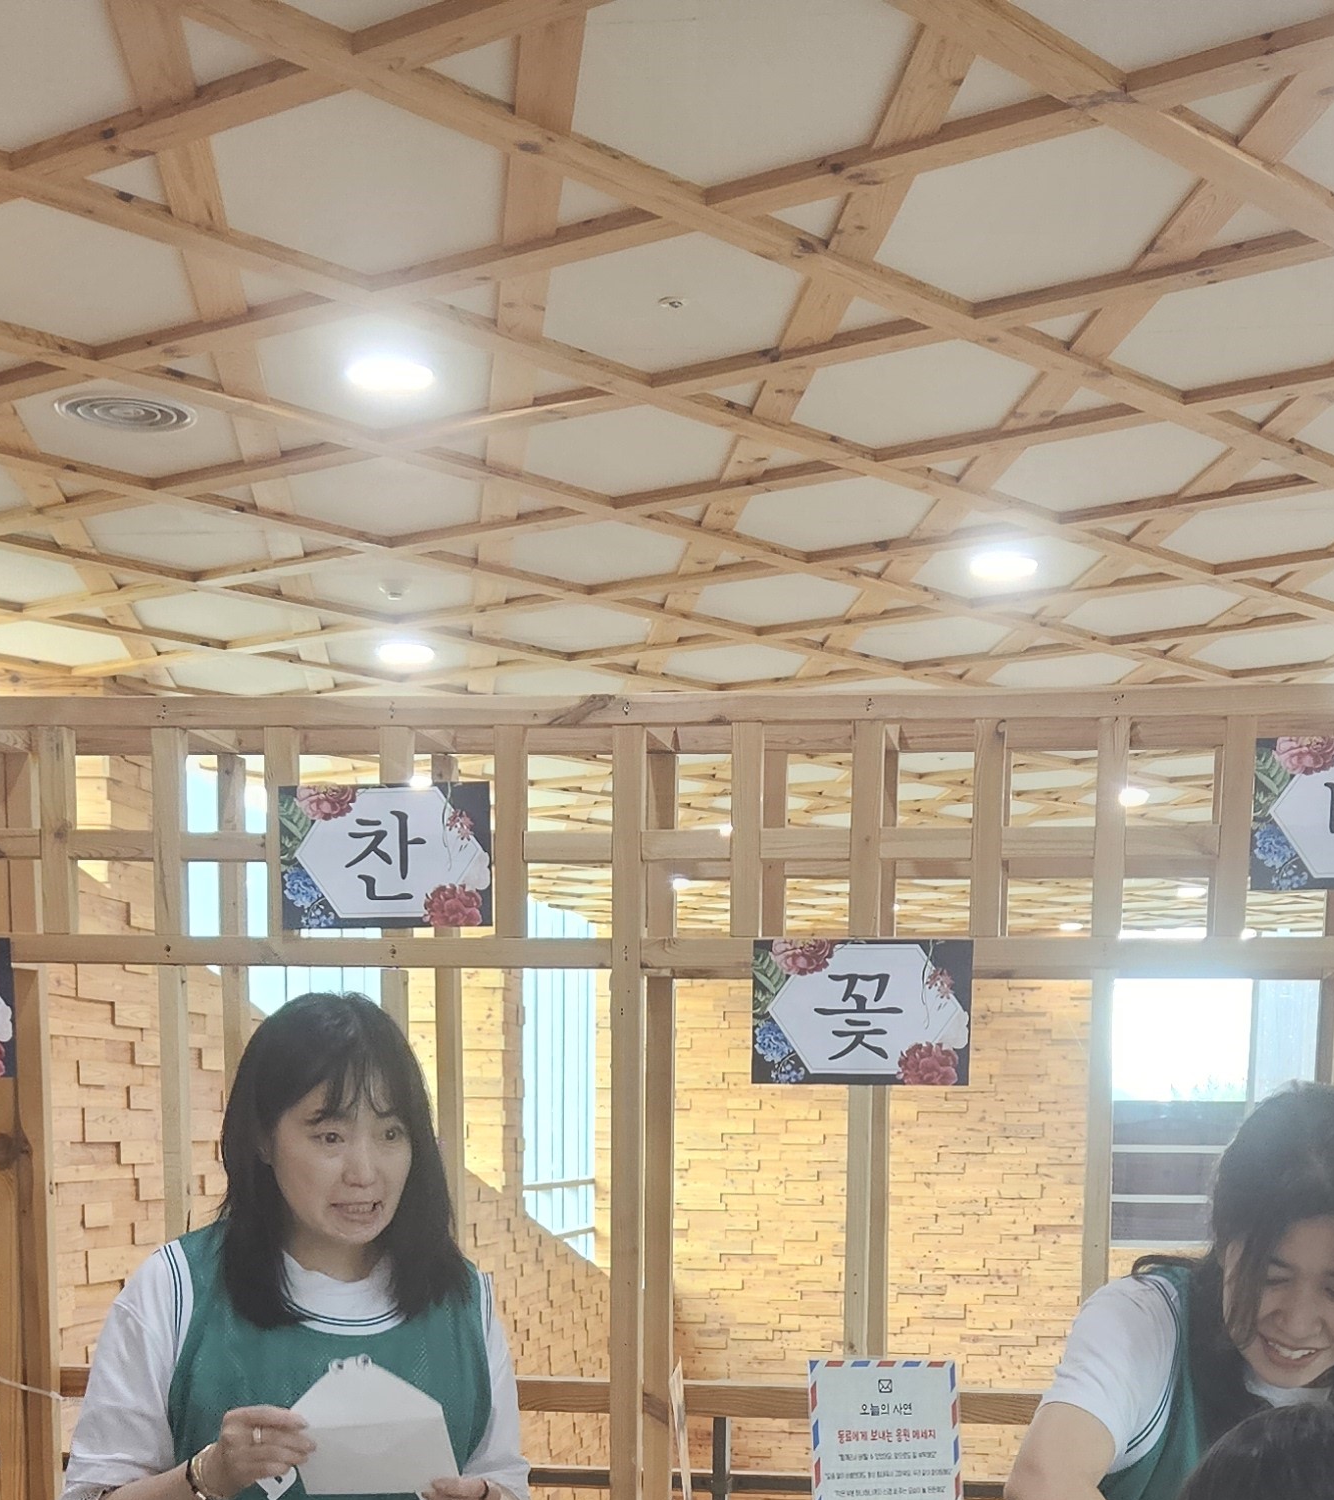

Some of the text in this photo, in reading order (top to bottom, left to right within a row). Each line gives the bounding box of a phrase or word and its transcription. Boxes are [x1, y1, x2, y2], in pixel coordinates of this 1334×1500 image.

[345, 810, 425, 900] 찬
[813, 971, 904, 1062] 꽃
[838, 1429, 868, 1444] 동료에게
[870, 1428, 893, 1443] 보내는
[860, 1403, 912, 1416] 오늘의 사연
